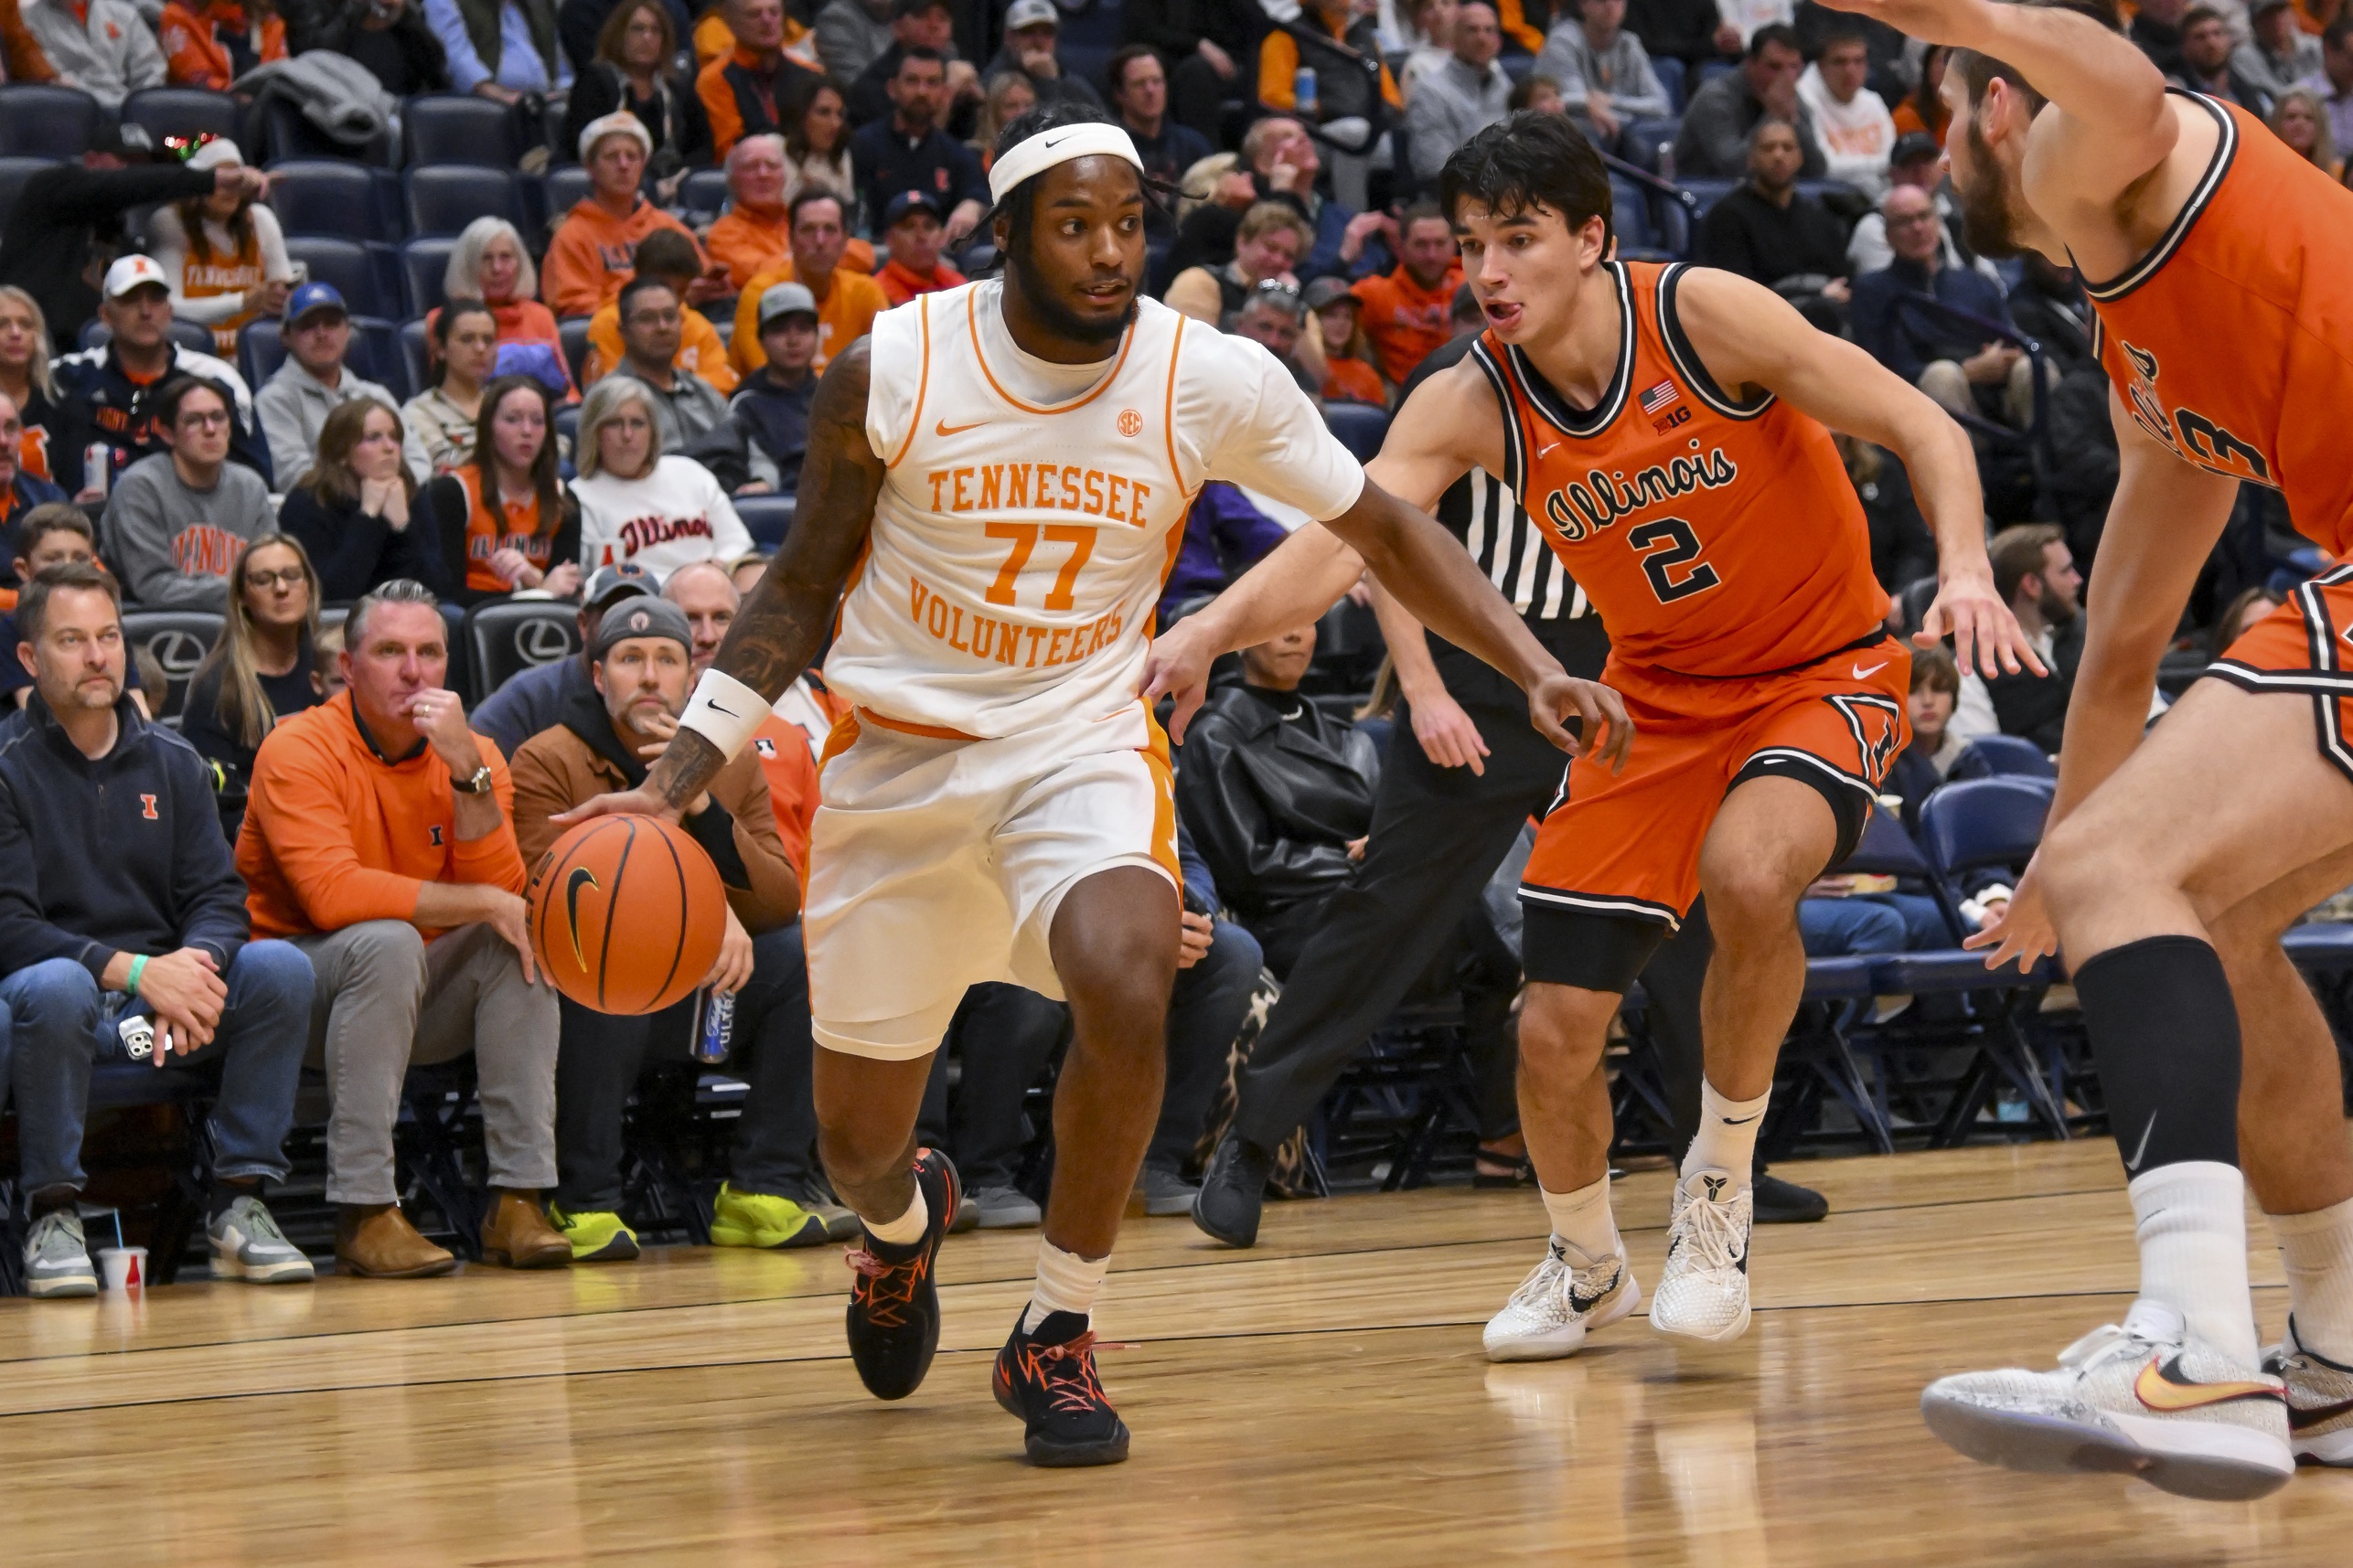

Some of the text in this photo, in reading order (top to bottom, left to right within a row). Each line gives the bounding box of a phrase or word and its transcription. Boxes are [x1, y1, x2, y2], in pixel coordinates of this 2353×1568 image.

[1119, 411, 1140, 435] SEC
[928, 463, 1150, 528] TENNESSEE
[1545, 439, 1738, 541] Illinois
[985, 522, 1098, 611] 77
[1626, 516, 1723, 604] 2
[910, 575, 1127, 668] VOLUNTEERS
